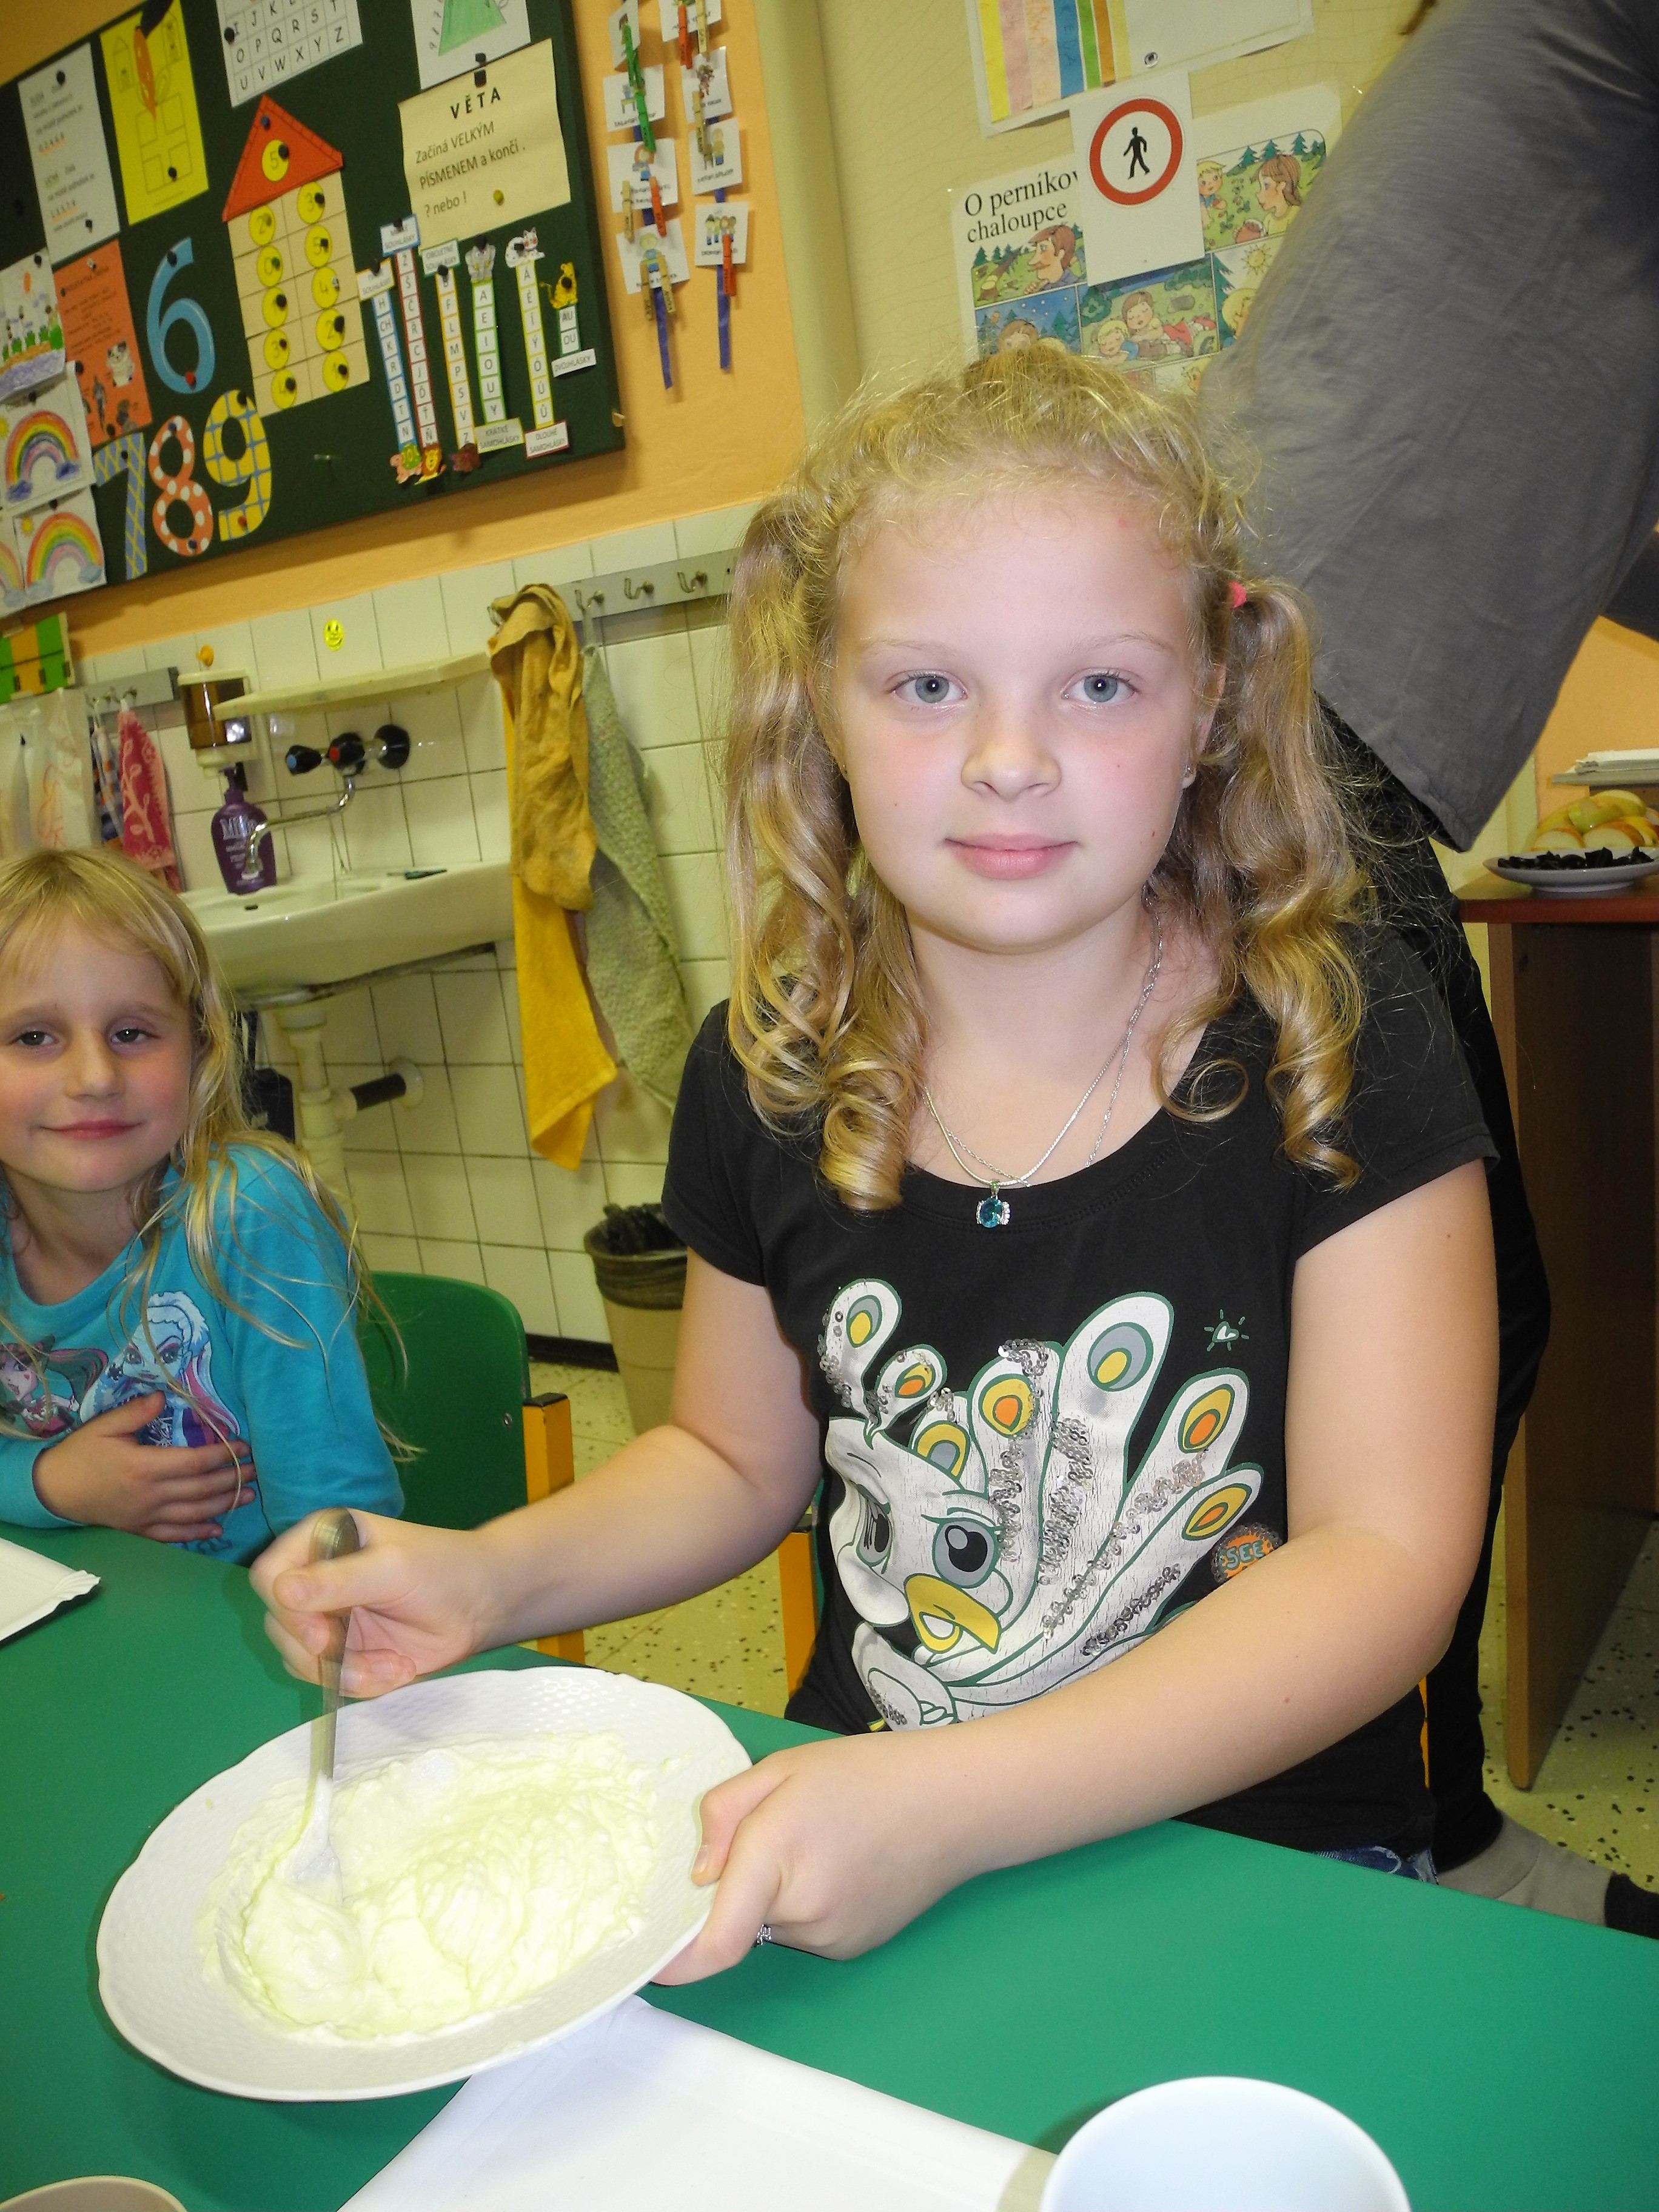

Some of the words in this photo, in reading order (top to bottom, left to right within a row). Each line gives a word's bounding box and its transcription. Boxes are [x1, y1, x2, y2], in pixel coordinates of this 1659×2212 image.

[252, 10, 257, 27] J
[269, 2, 277, 16] K
[236, 49, 244, 63] O
[255, 38, 261, 52] P
[272, 28, 283, 44] Q
[292, 19, 300, 33] R
[311, 8, 319, 24] S
[240, 76, 247, 90] U
[258, 66, 265, 81] V
[274, 55, 286, 72] W
[295, 46, 304, 62] X
[313, 36, 321, 52] Y
[335, 26, 344, 42] Z
[451, 121, 495, 149] VELKÝM
[270, 150, 279, 170] 5
[419, 156, 478, 190] PÍSMENEM
[480, 156, 488, 166] a
[489, 138, 519, 163] končí
[433, 195, 460, 215] nebo
[965, 193, 982, 216] O
[256, 215, 265, 235] 2
[306, 193, 314, 212] 3
[967, 203, 1067, 243] chaloupce
[264, 257, 272, 275] 0
[313, 236, 321, 255] 5
[480, 290, 488, 301] A
[527, 290, 532, 304] É
[378, 300, 385, 309] H
[446, 298, 451, 310] F
[146, 236, 215, 394] 6
[481, 313, 487, 324] E
[562, 312, 573, 322] AU
[380, 320, 392, 332] CH
[449, 323, 454, 332] L
[272, 341, 280, 358] 3
[326, 320, 334, 339] 2
[532, 335, 538, 348] Ý
[563, 335, 576, 345] OU
[387, 341, 393, 351] K
[414, 344, 420, 356] C
[450, 343, 459, 355] M
[391, 361, 397, 372] R
[484, 359, 493, 370] O
[534, 359, 541, 372] Ó
[455, 366, 461, 377] P
[395, 383, 401, 394] D
[458, 387, 464, 398] S
[487, 382, 494, 393] U
[537, 381, 545, 395] Ú
[399, 405, 403, 415] T
[460, 410, 467, 421] V
[491, 404, 497, 415] Y
[402, 426, 409, 436] N
[463, 432, 469, 443] Z
[94, 432, 147, 580] 7
[148, 415, 213, 557] 8
[203, 389, 272, 541] 9
[1225, 1540, 1265, 1569] SEE
